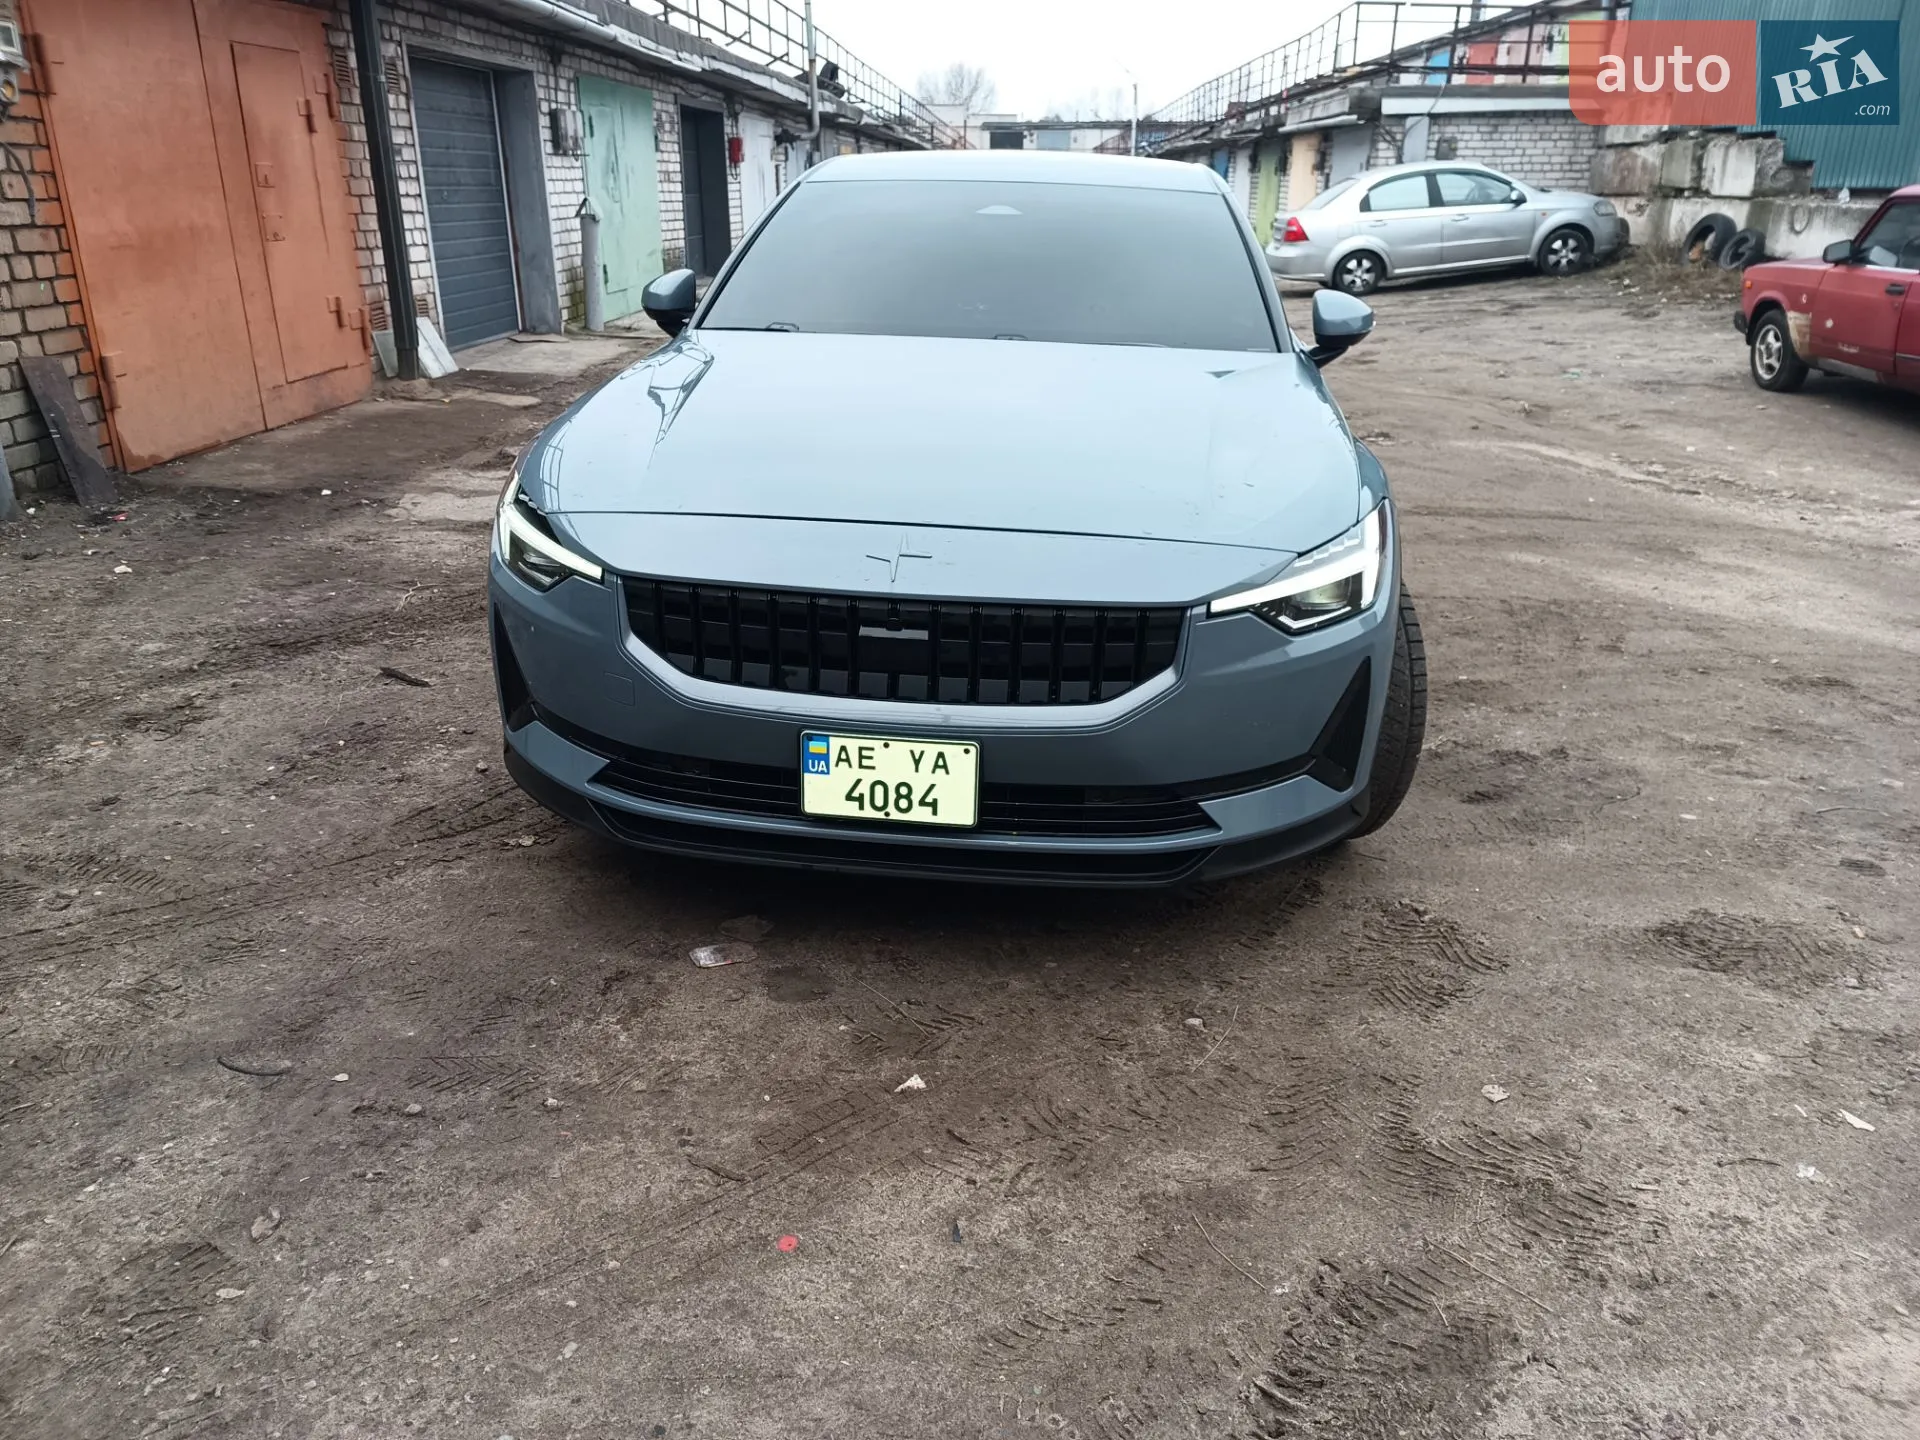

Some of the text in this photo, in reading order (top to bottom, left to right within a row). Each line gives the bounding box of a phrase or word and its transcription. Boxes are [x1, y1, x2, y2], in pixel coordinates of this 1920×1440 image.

[808, 759, 828, 773] UA
[834, 745, 950, 775] AE YA
[845, 778, 938, 816] 4084
